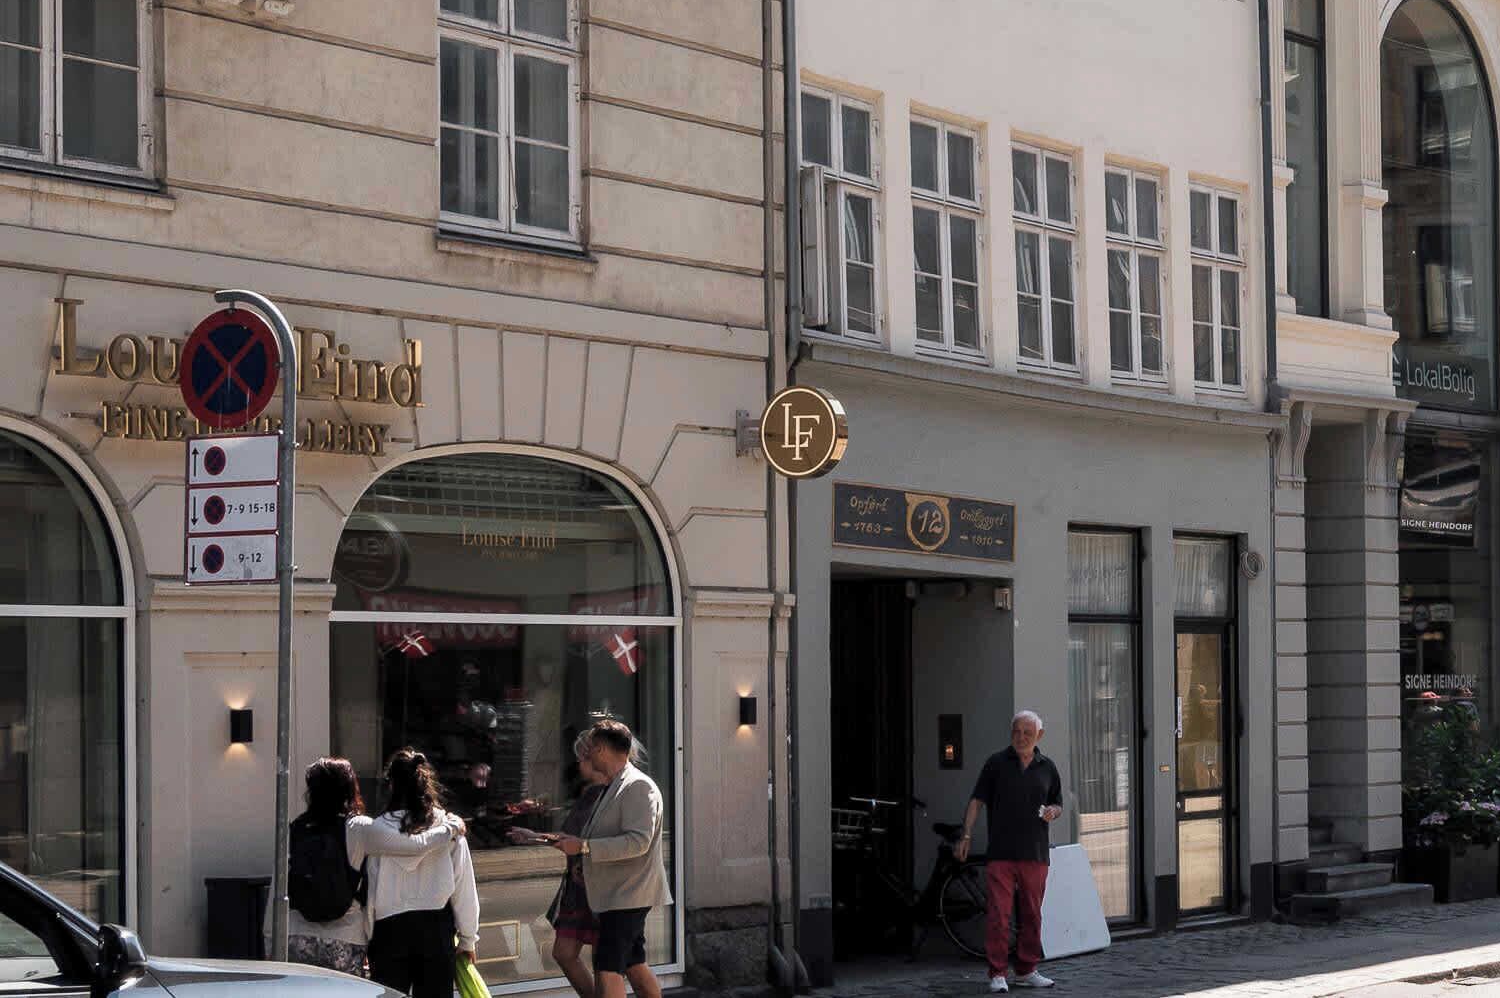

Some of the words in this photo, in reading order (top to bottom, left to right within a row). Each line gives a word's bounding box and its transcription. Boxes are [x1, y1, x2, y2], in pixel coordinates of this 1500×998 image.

[51, 297, 186, 385] Lou
[294, 326, 425, 408] Find
[1406, 358, 1475, 401] LokalBolig
[101, 401, 185, 440] FINE
[781, 402, 821, 461] LF
[227, 504, 245, 515] 7-9
[249, 502, 276, 514] 15-18
[918, 509, 944, 534] 12
[1401, 519, 1427, 528] SIGNE
[1428, 521, 1473, 531] HEINDORF
[462, 524, 514, 547] Louise
[238, 553, 262, 563] 9-12
[1405, 673, 1432, 690] SIGNE
[1433, 673, 1477, 690] HEINDORF
